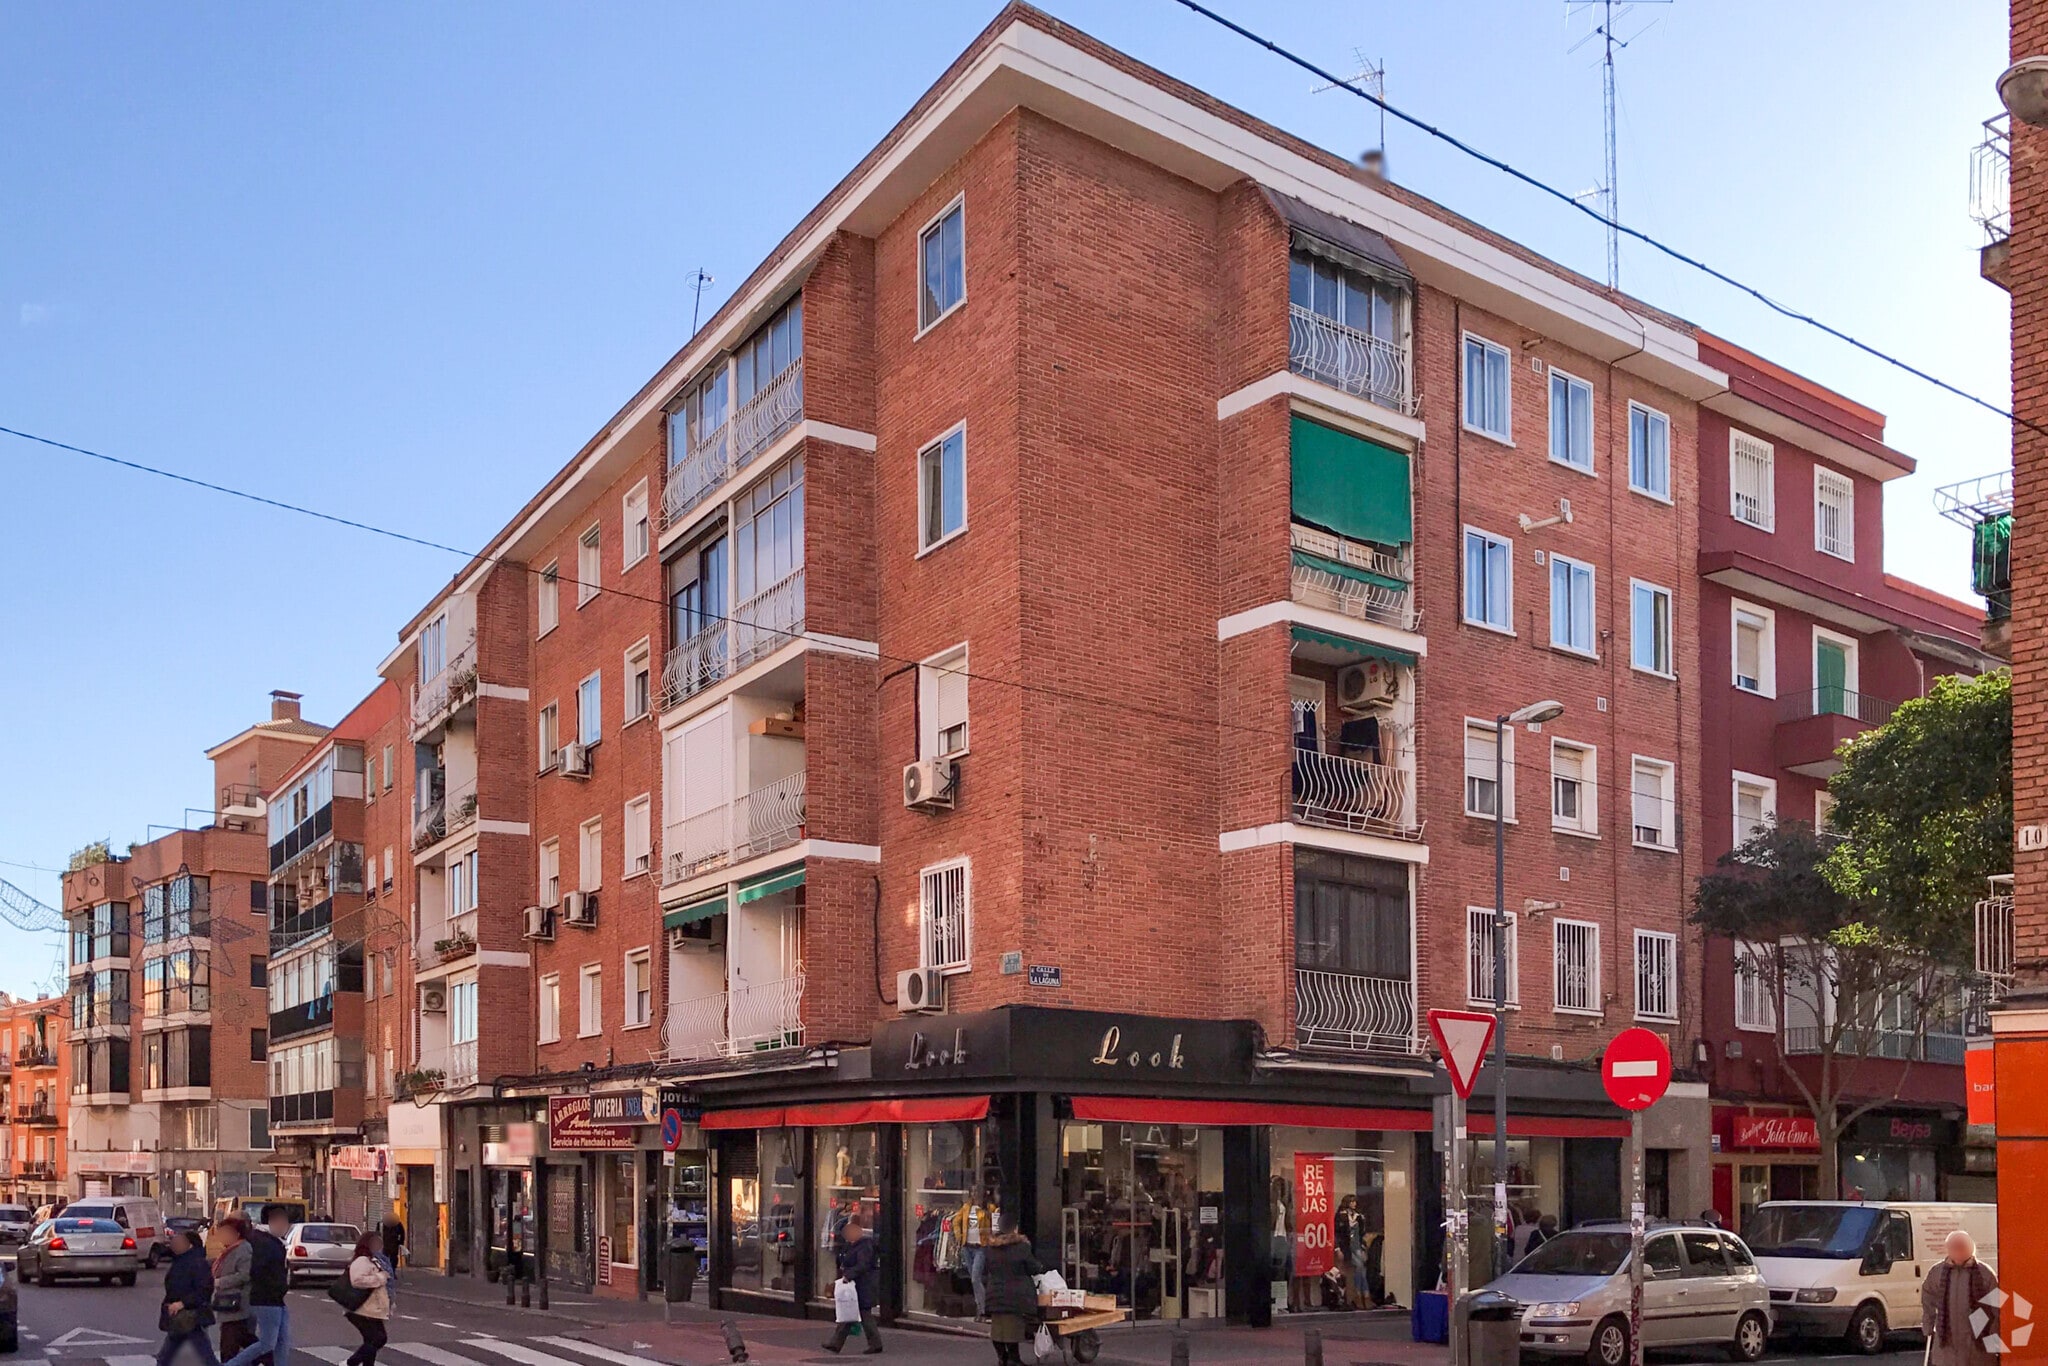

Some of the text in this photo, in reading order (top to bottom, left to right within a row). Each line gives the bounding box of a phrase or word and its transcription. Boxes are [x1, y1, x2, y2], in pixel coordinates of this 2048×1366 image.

[2025, 829, 2042, 846] 10
[1039, 977, 1060, 985] LAGUNA
[904, 1027, 967, 1070] Look
[1092, 1025, 1185, 1069] Look
[663, 1092, 701, 1104] JOYERI
[593, 1097, 623, 1118] JOYERIA
[1761, 1119, 1785, 1145] Jota
[1787, 1121, 1808, 1144] Eme
[1891, 1118, 1931, 1141] Beysa
[553, 1138, 573, 1147] Servicio
[574, 1138, 580, 1147] de
[581, 1138, 606, 1147] Planchado
[1305, 1165, 1324, 1180] RE
[1305, 1181, 1325, 1196] BA
[1302, 1198, 1327, 1213] JAS
